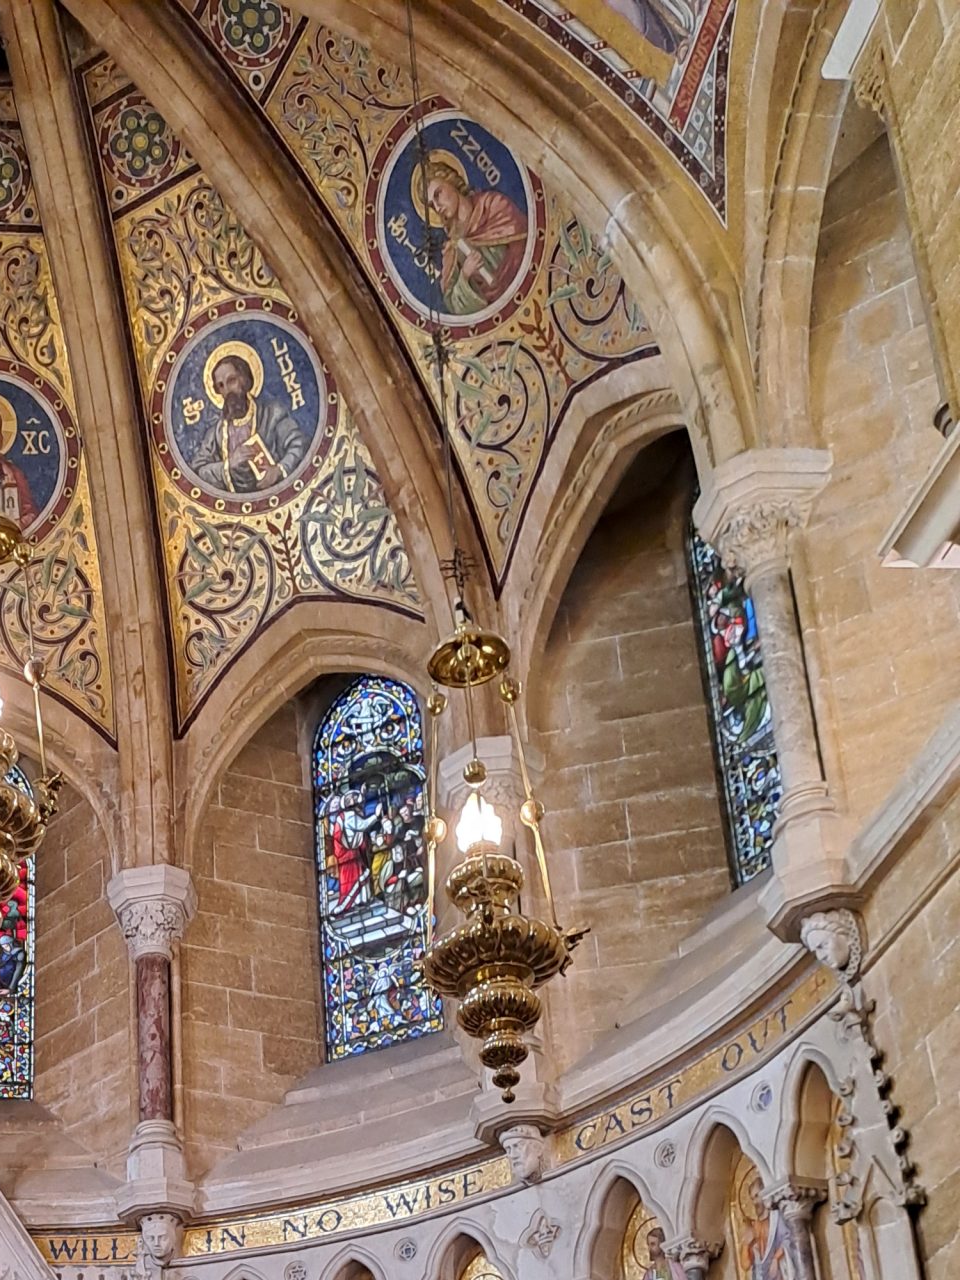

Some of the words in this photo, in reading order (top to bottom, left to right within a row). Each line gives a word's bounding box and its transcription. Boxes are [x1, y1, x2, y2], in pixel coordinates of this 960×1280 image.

[271, 337, 306, 411] LUKA
[574, 1079, 682, 1151] CAST
[721, 1000, 793, 1072] OUT
[48, 1238, 130, 1261] WILL
[205, 1226, 246, 1252] IN
[282, 1209, 343, 1242] NO
[383, 1168, 484, 1218] WISE
